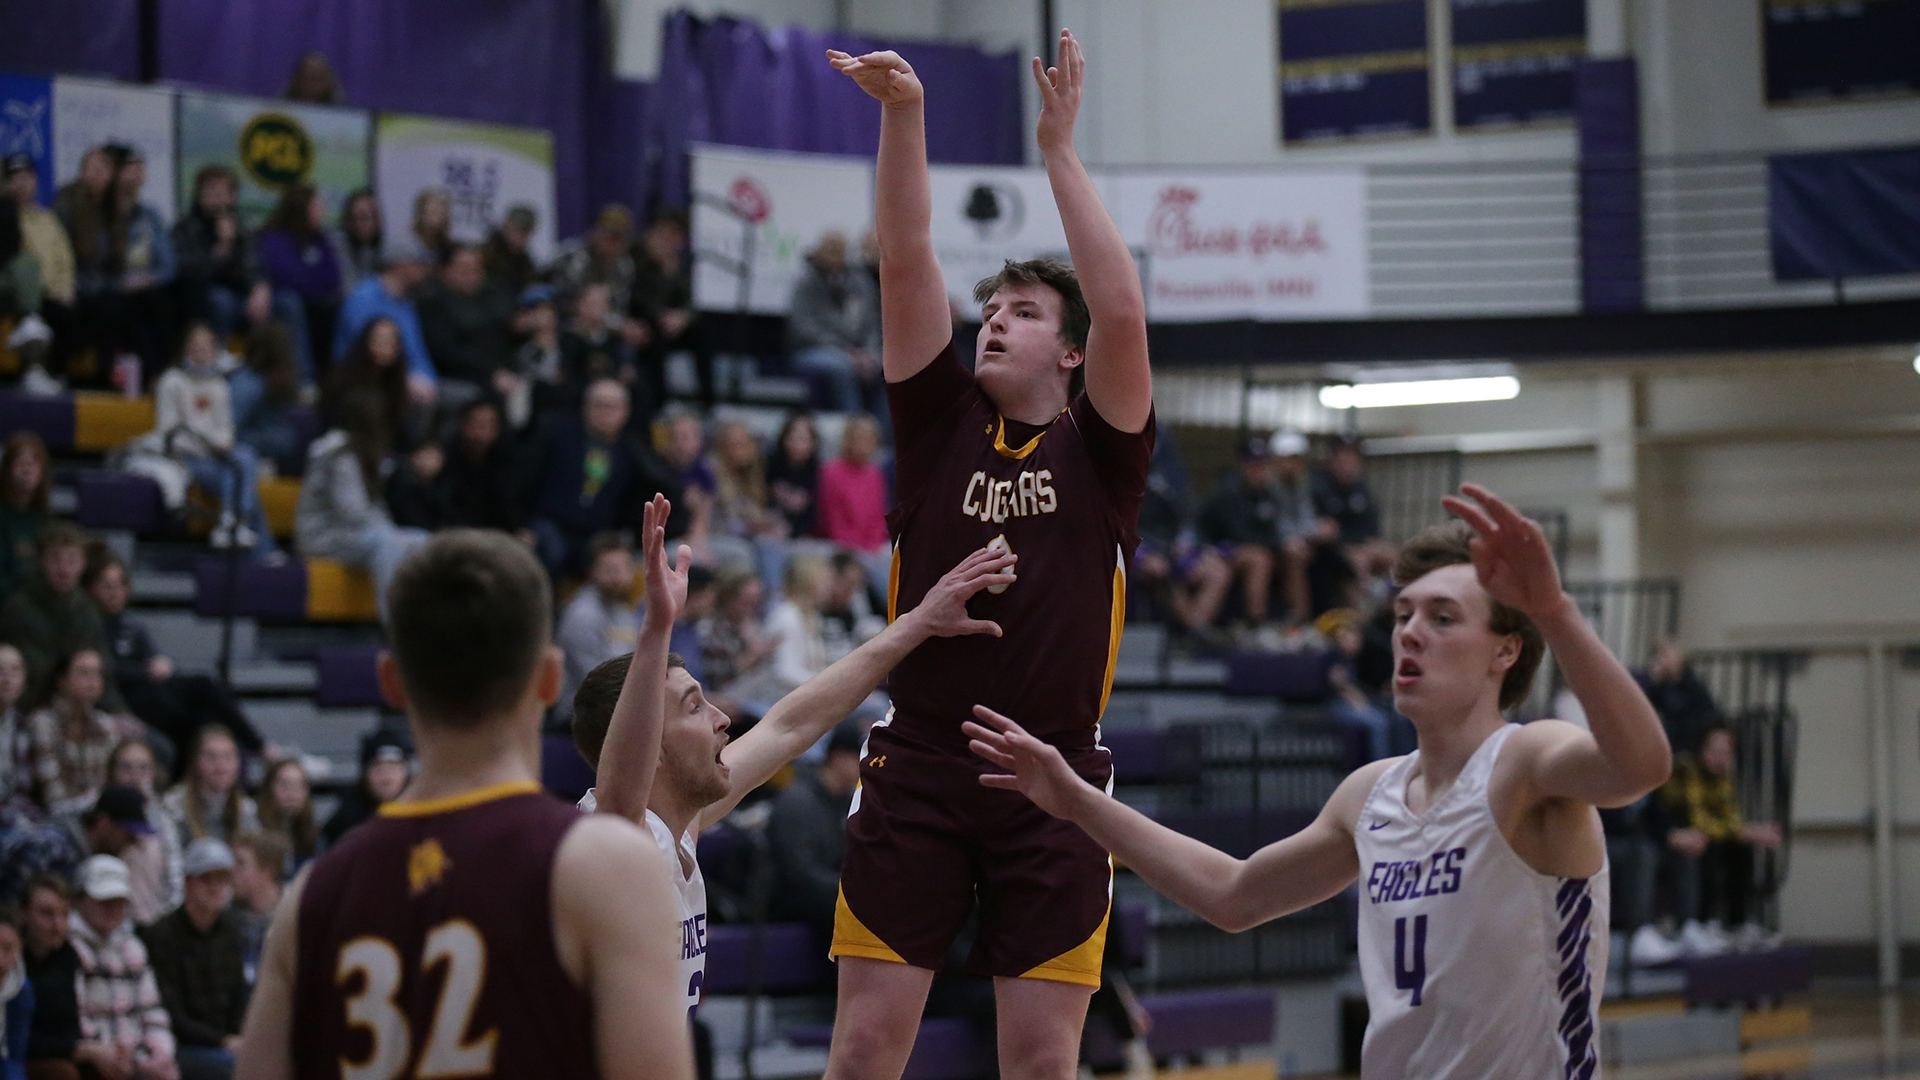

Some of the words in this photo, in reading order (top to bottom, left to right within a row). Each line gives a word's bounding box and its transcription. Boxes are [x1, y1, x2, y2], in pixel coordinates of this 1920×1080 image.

[1367, 847, 1467, 904] EAGLES
[679, 912, 707, 960] AGLE
[1394, 914, 1428, 1007] 4
[334, 917, 499, 1080] 32
